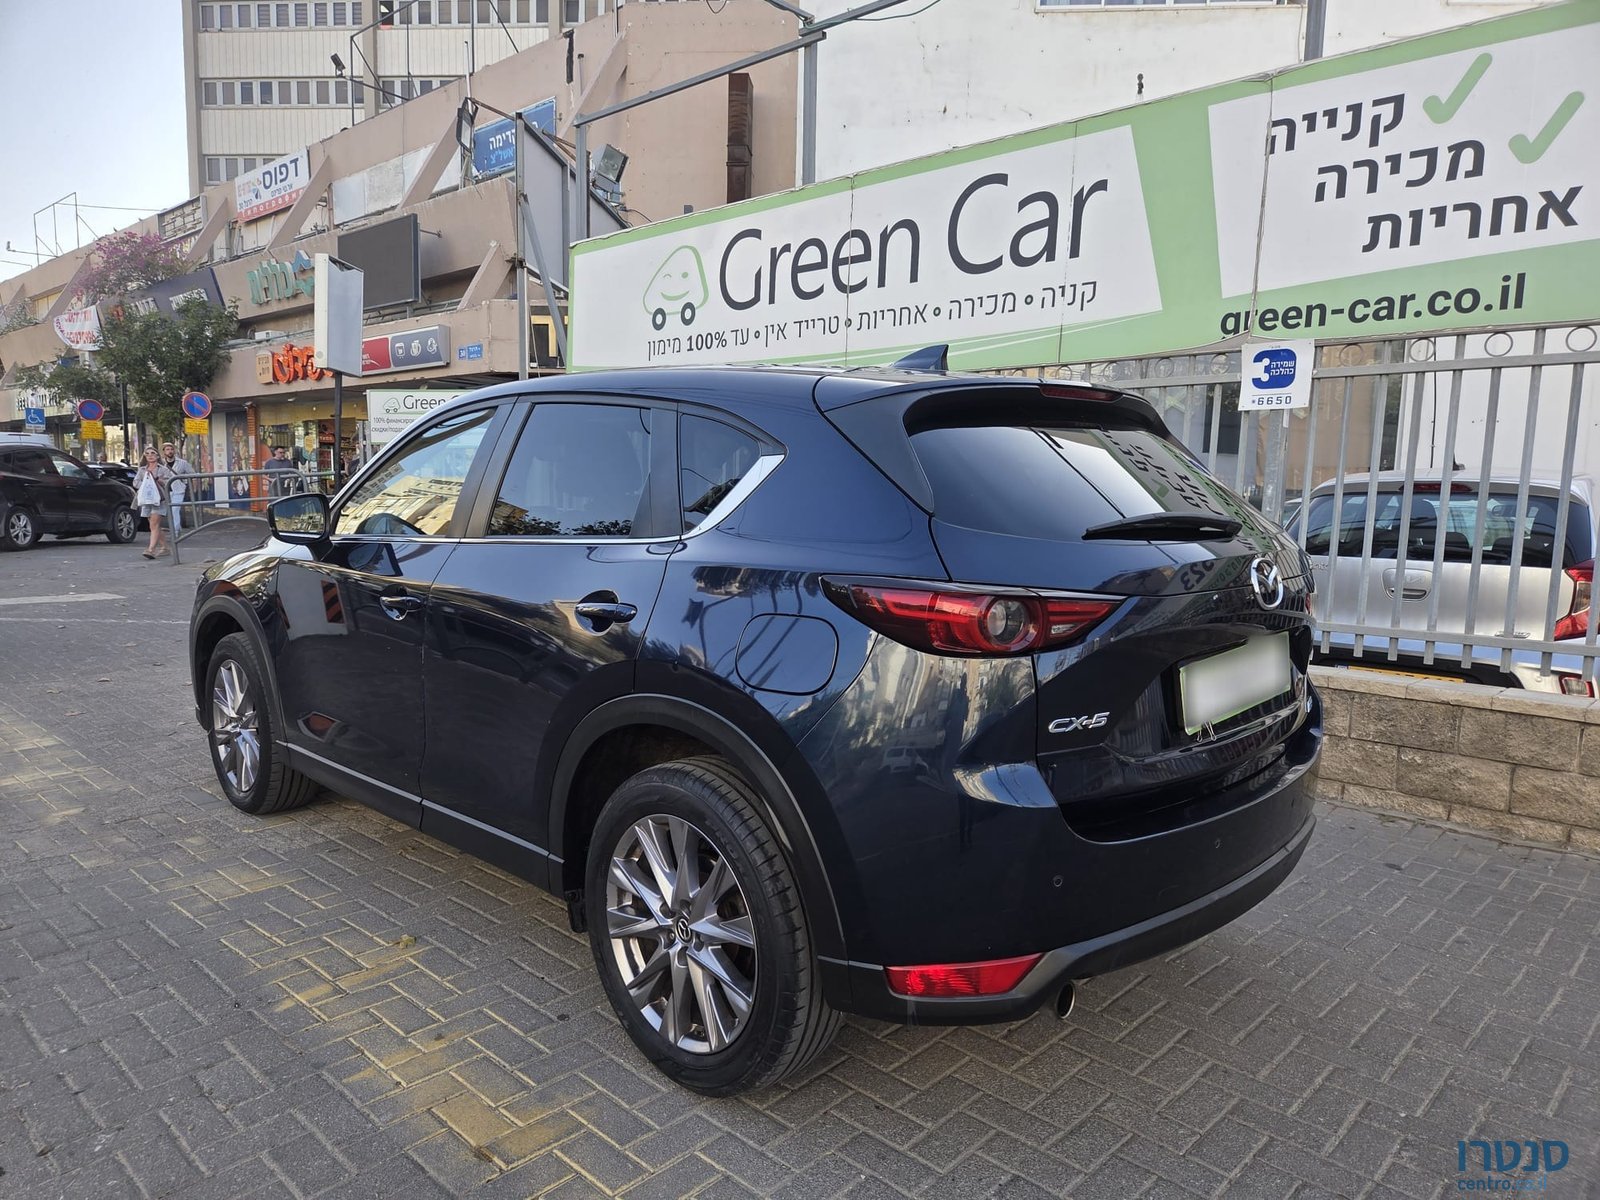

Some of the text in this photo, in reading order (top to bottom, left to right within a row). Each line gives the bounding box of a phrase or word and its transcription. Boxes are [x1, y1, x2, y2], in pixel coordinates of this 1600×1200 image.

[1267, 93, 1406, 155] קנייה
[262, 157, 299, 190] דפוס
[1315, 139, 1486, 203] מכירה
[718, 172, 1109, 312] Green Car
[1361, 185, 1584, 253] אחריות
[647, 280, 1098, 361] קניה מכירה אחריות טרייד אין עד 100% מימון
[1219, 271, 1527, 339] green-car.co.il
[1270, 360, 1295, 369] שמירה
[1270, 368, 1295, 376] כהלכה
[403, 395, 446, 410] Green
[1047, 711, 1110, 734] CX-5
